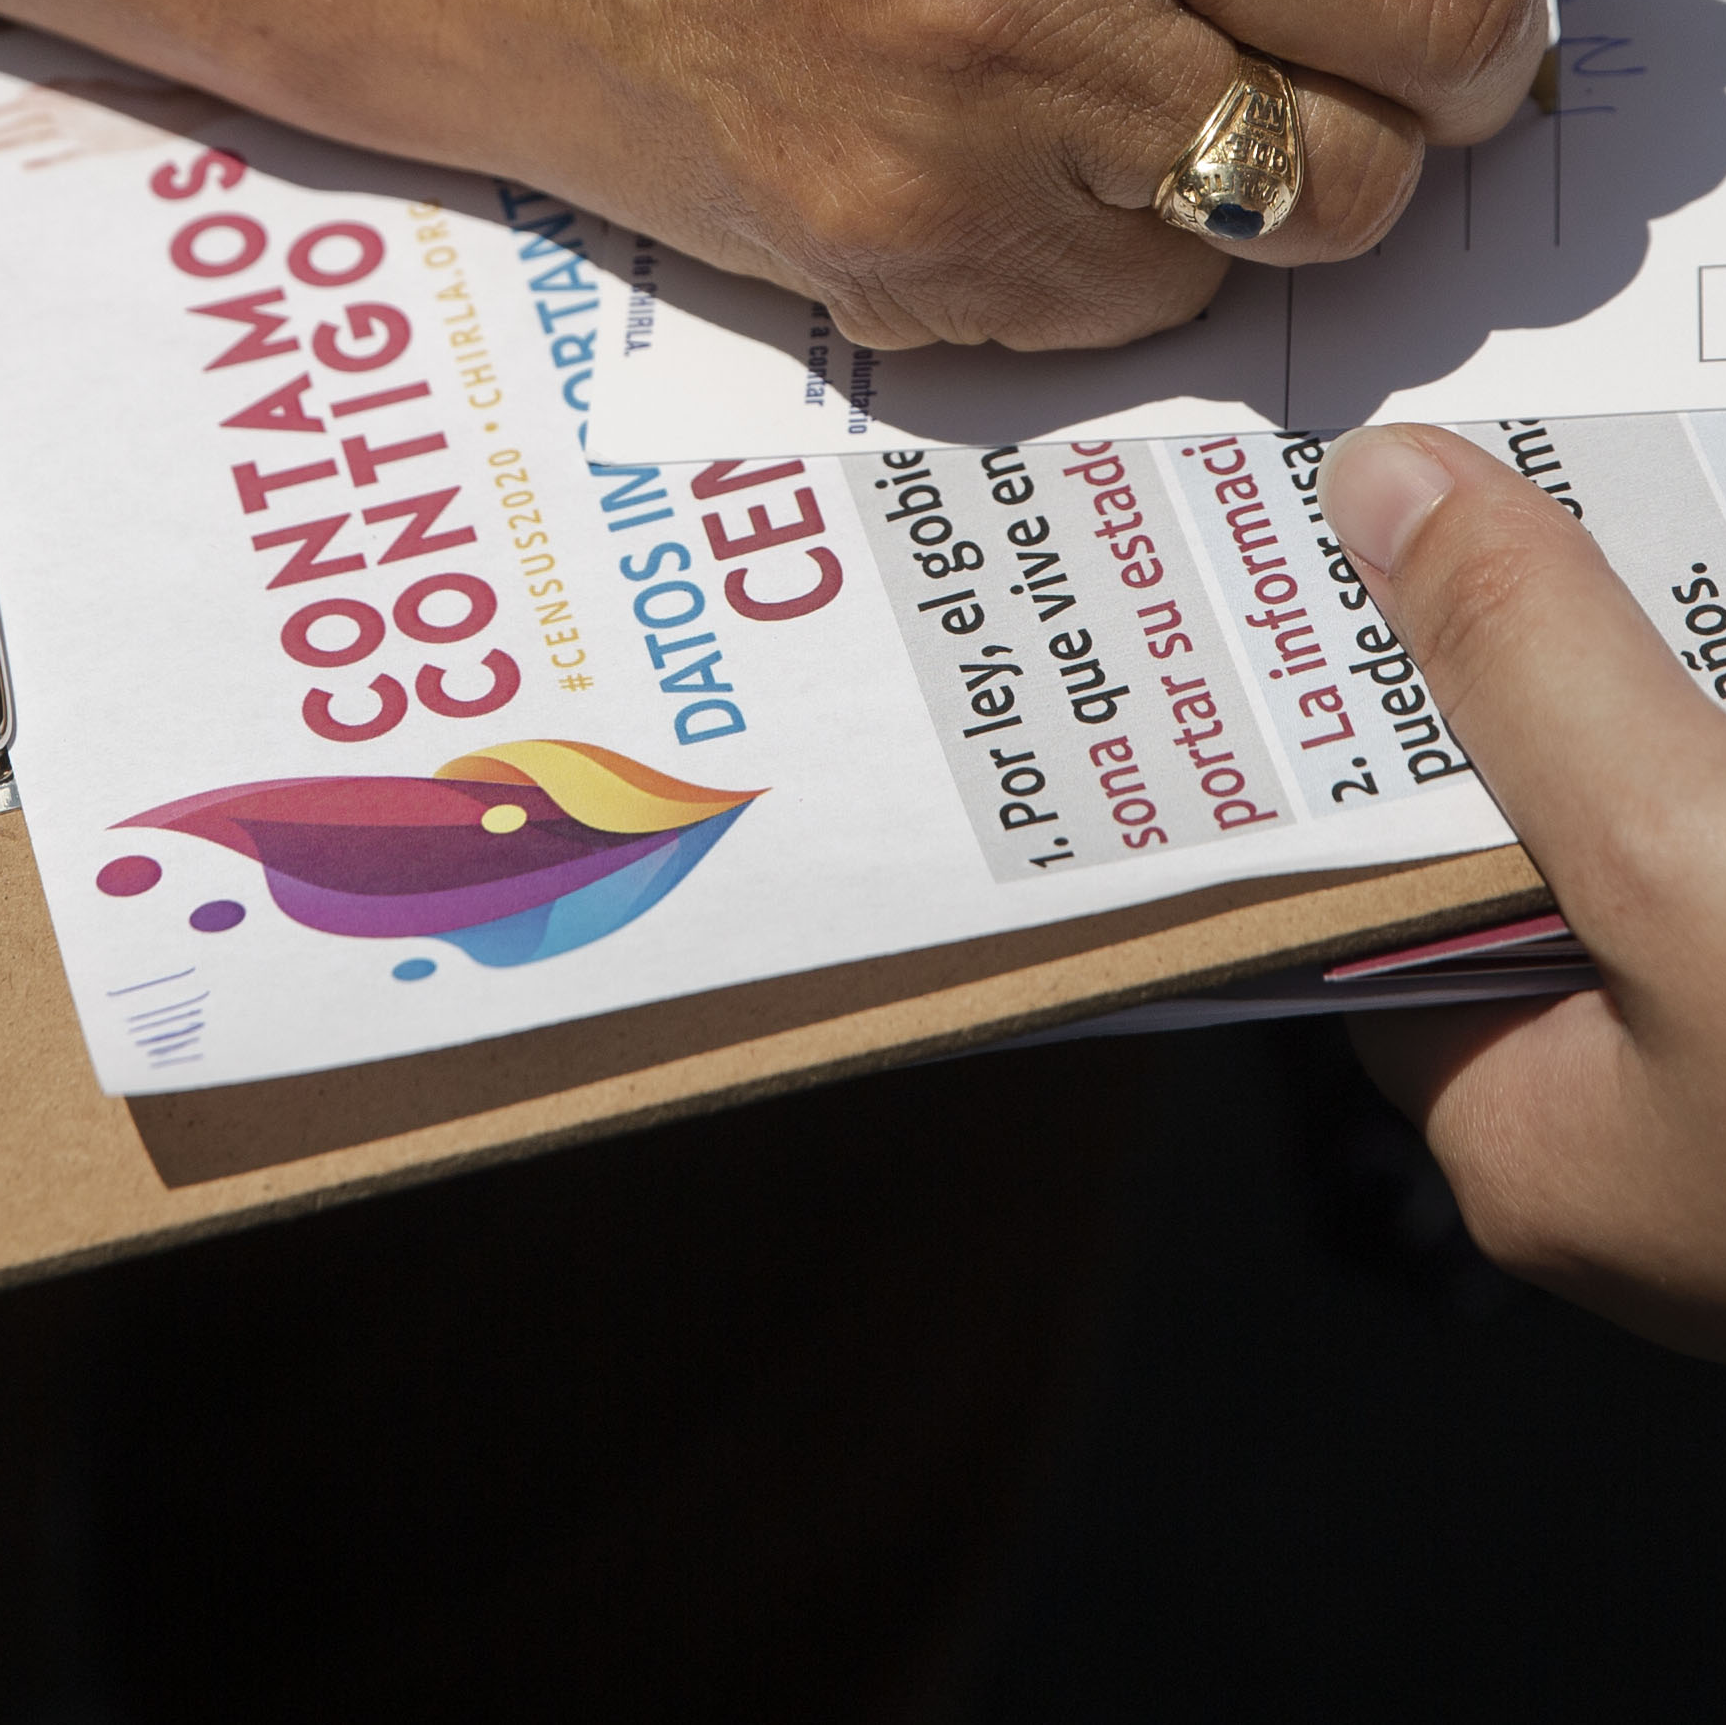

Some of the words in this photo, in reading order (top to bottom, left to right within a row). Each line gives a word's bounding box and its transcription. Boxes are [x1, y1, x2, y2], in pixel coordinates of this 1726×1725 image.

[422, 199, 505, 413] CHIRLA.ORG
[633, 254, 656, 277] de
[623, 280, 656, 358] CHIRLA.
[803, 345, 830, 406] contar
[846, 346, 878, 435] oluntario
[150, 148, 408, 742] CONTAMOS
[286, 221, 522, 719] CONTIGO
[986, 447, 1034, 506] en
[487, 449, 594, 693] #CENSUS2020
[1006, 515, 1077, 623] vive
[1182, 435, 1328, 678] informaci
[619, 541, 747, 746] DATOS
[917, 588, 985, 636] el
[1136, 599, 1194, 660] su
[958, 644, 1024, 739] ley,
[1048, 628, 1131, 725] que
[1298, 684, 1356, 751] La
[1349, 614, 1471, 784] puede
[989, 748, 1060, 832] Por
[1088, 735, 1169, 850] sona
[1160, 675, 1279, 831] portar
[1331, 756, 1380, 803] 2.
[1029, 837, 1075, 869] 1.
